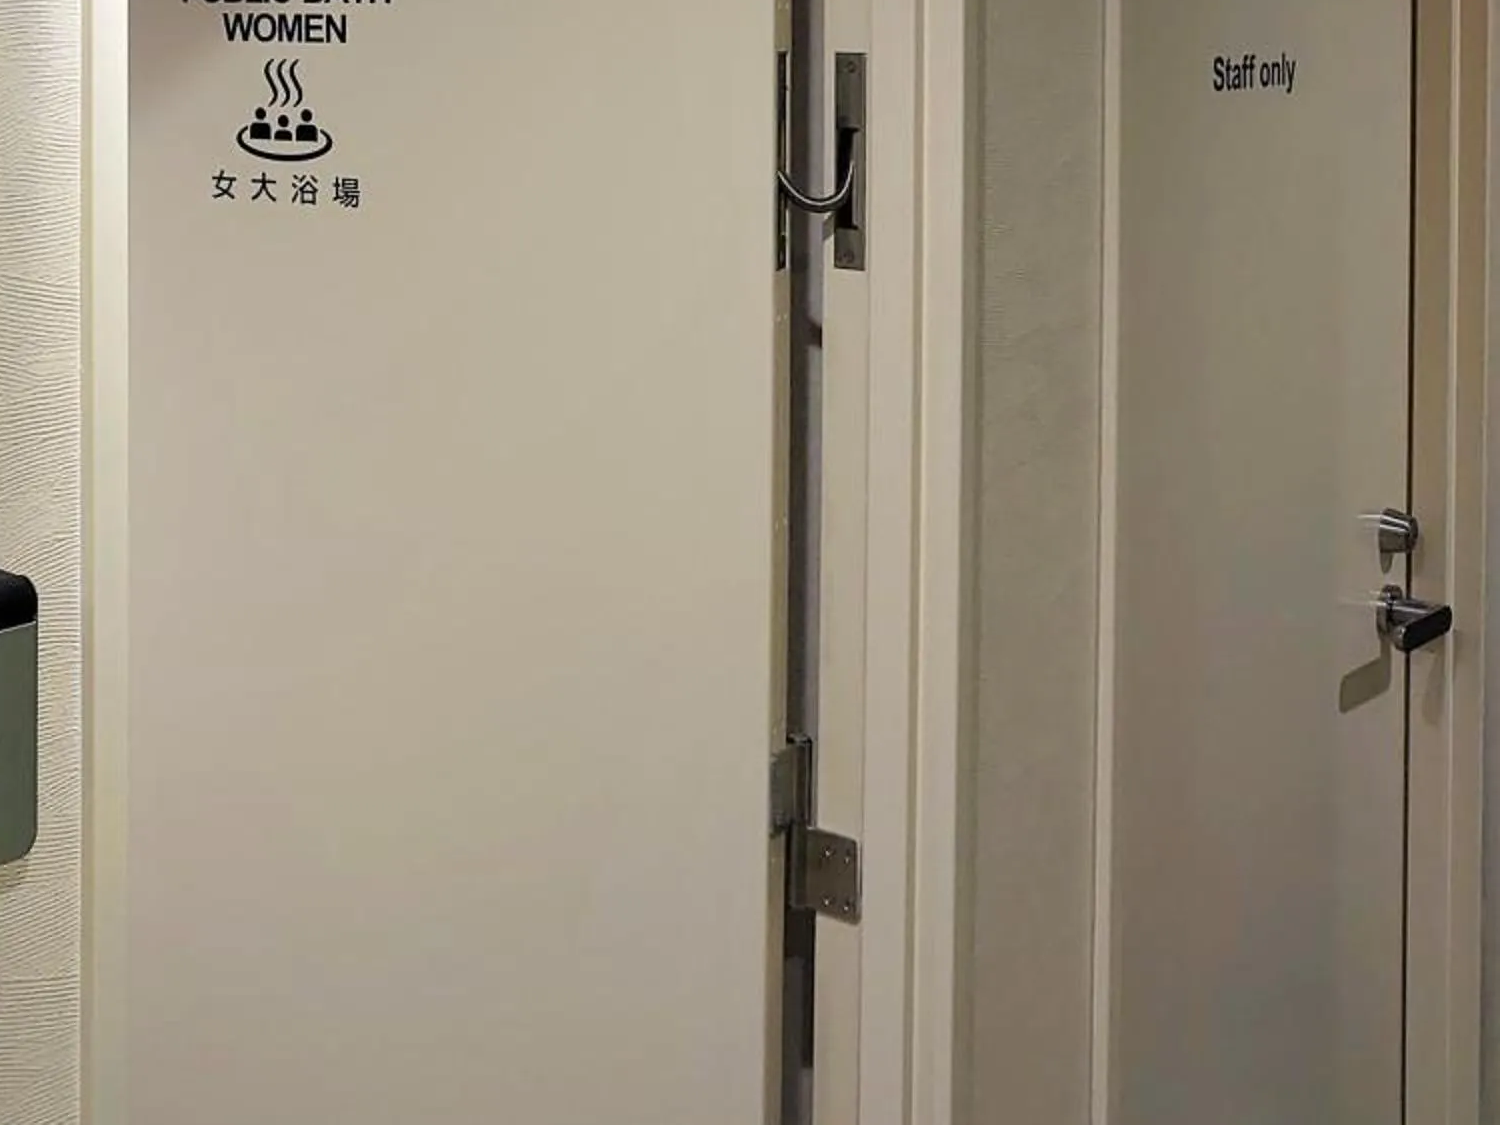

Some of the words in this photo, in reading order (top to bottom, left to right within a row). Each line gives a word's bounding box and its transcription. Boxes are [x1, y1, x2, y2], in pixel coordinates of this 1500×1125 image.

[223, 13, 347, 43] WOMEN
[1213, 54, 1256, 92] Staff
[1260, 52, 1297, 94] only
[211, 169, 360, 208] 女大浴場
